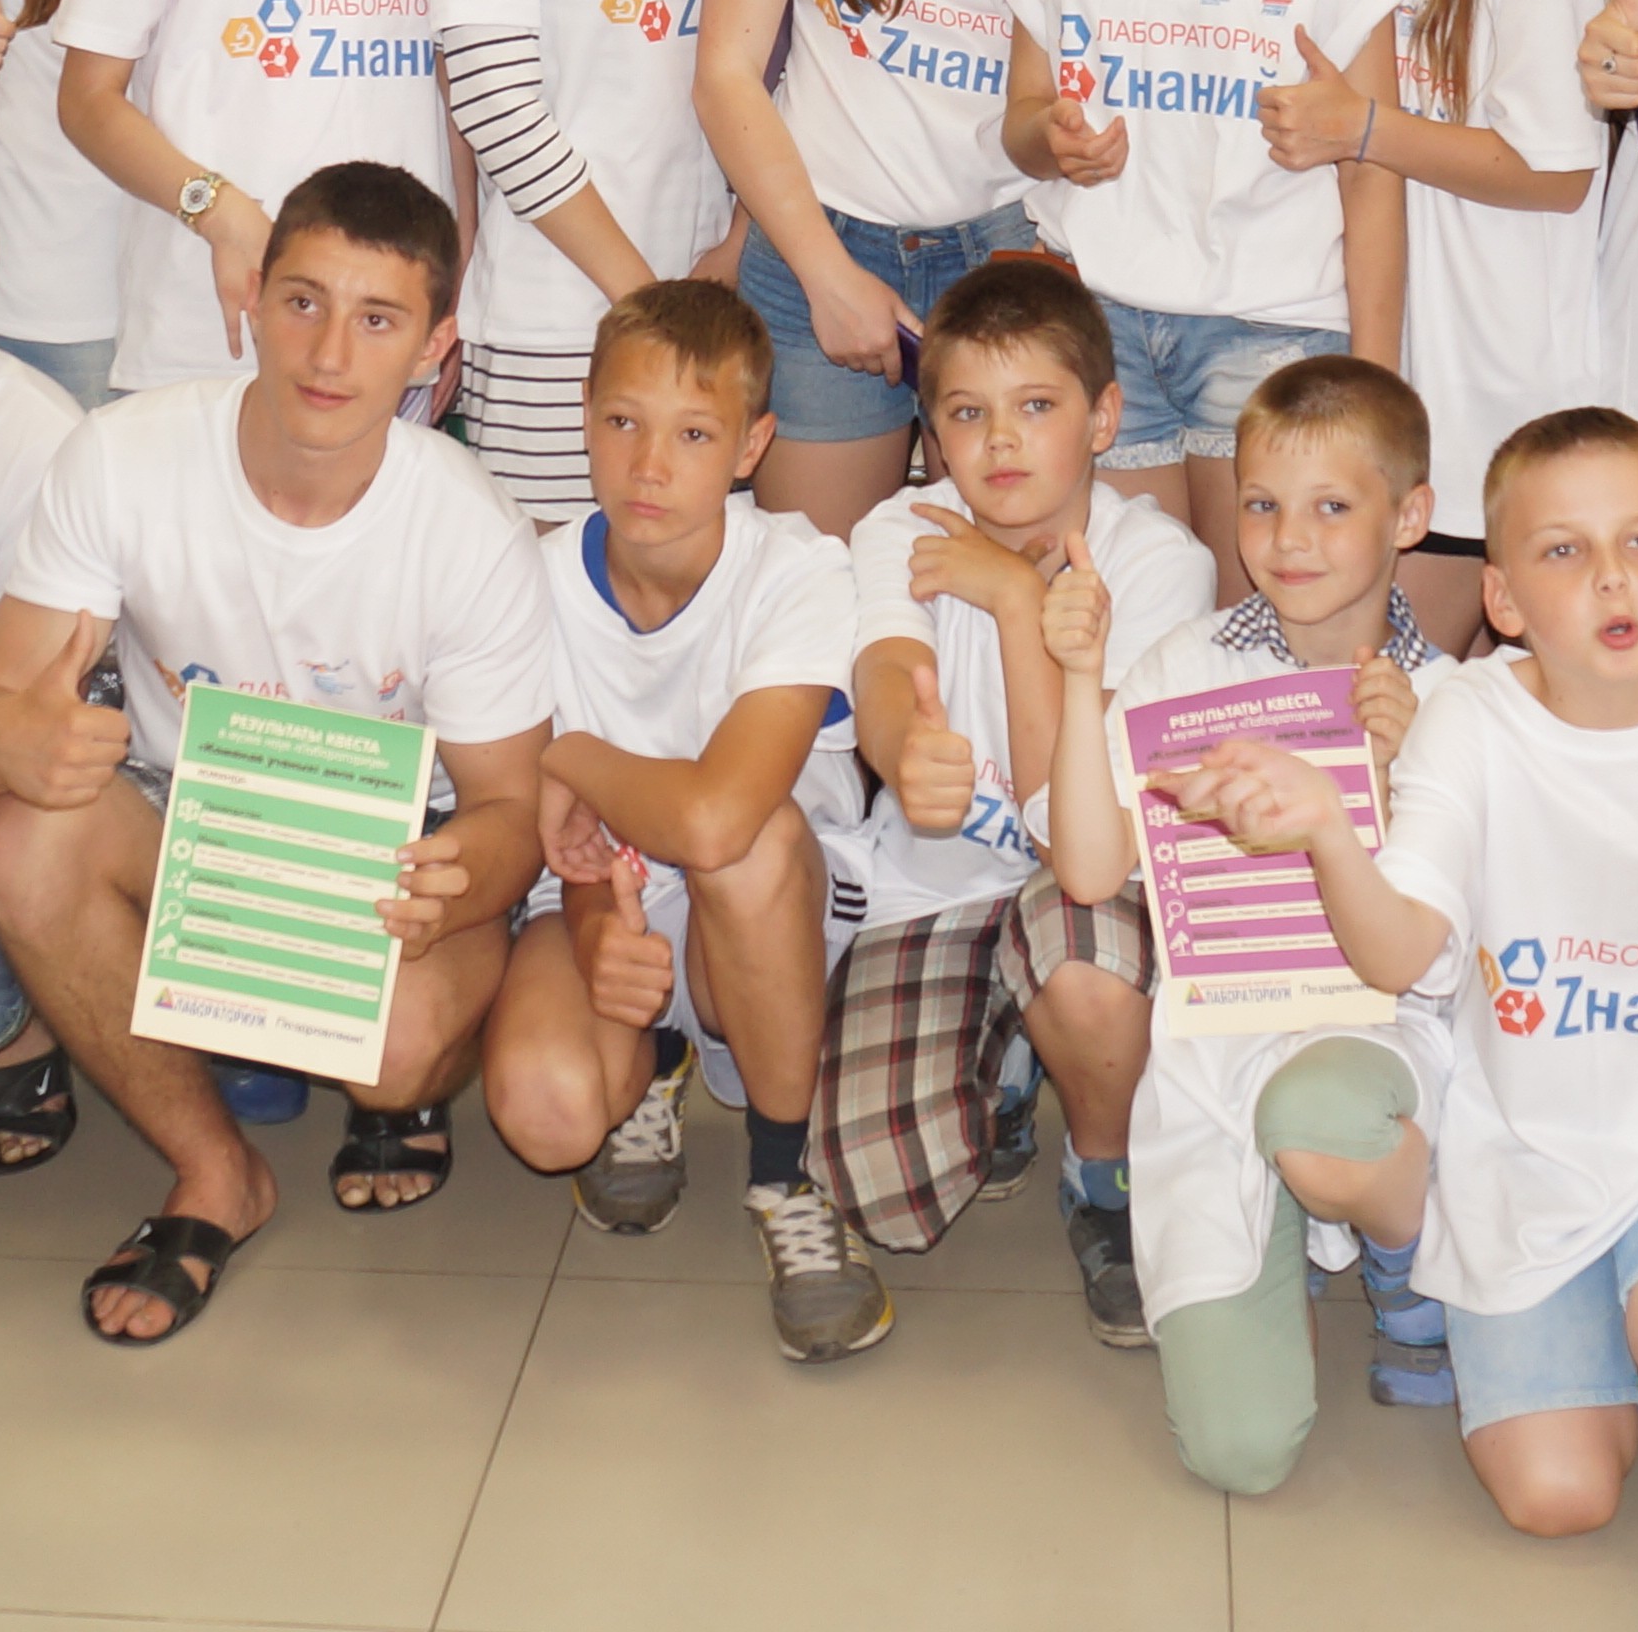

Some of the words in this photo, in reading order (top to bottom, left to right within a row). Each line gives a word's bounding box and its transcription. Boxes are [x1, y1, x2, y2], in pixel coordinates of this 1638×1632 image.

[878, 25, 1005, 95] Zнан
[1097, 19, 1281, 64] ЛАБОРАТОРИЯ
[1168, 699, 1263, 729] РЕЗУЛЬТАТЫ
[1265, 691, 1322, 712] КВЕСТА
